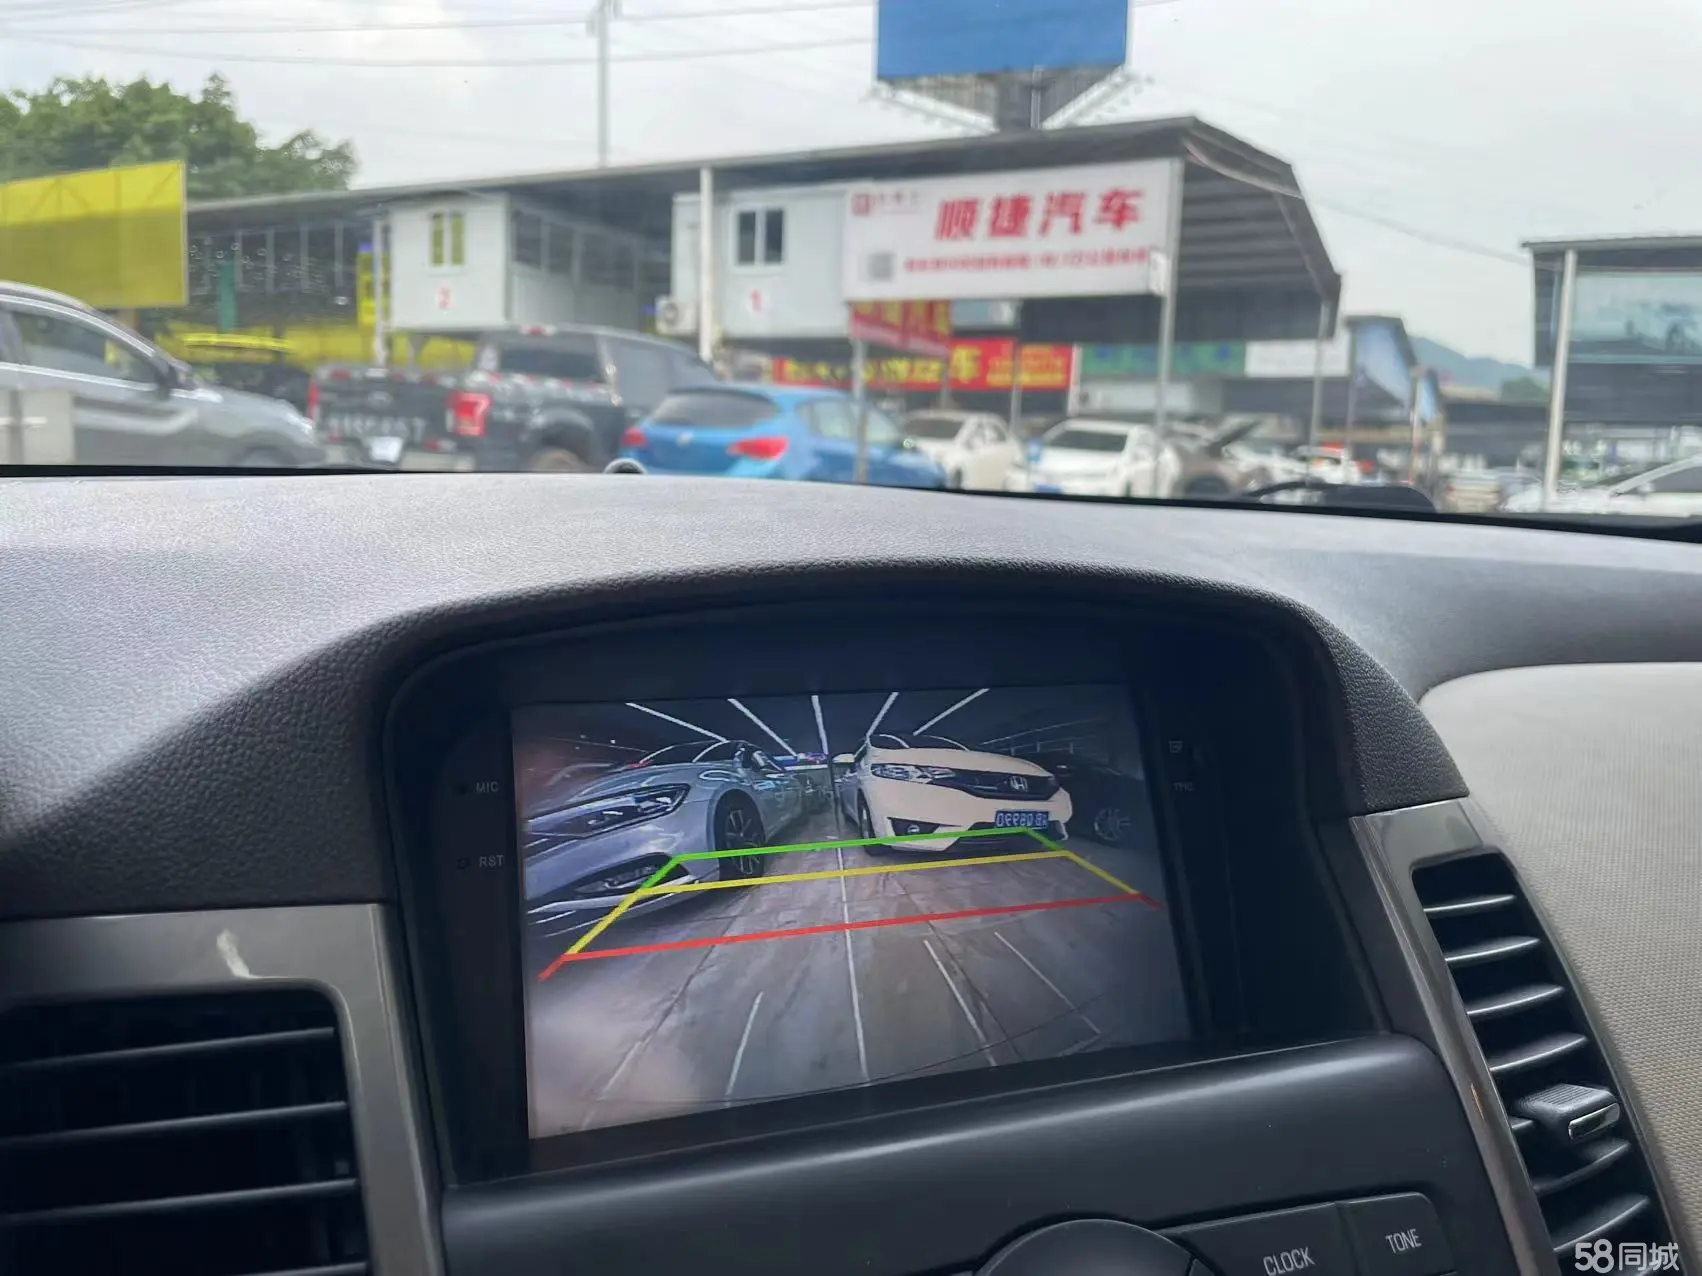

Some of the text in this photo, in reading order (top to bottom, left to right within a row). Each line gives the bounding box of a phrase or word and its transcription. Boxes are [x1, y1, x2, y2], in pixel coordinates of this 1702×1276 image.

[936, 188, 1143, 239] 顺捷汽车
[476, 781, 499, 793] MIC
[479, 854, 504, 867] RST
[1385, 1228, 1422, 1254] TONE
[1263, 1247, 1315, 1276] CLOCK
